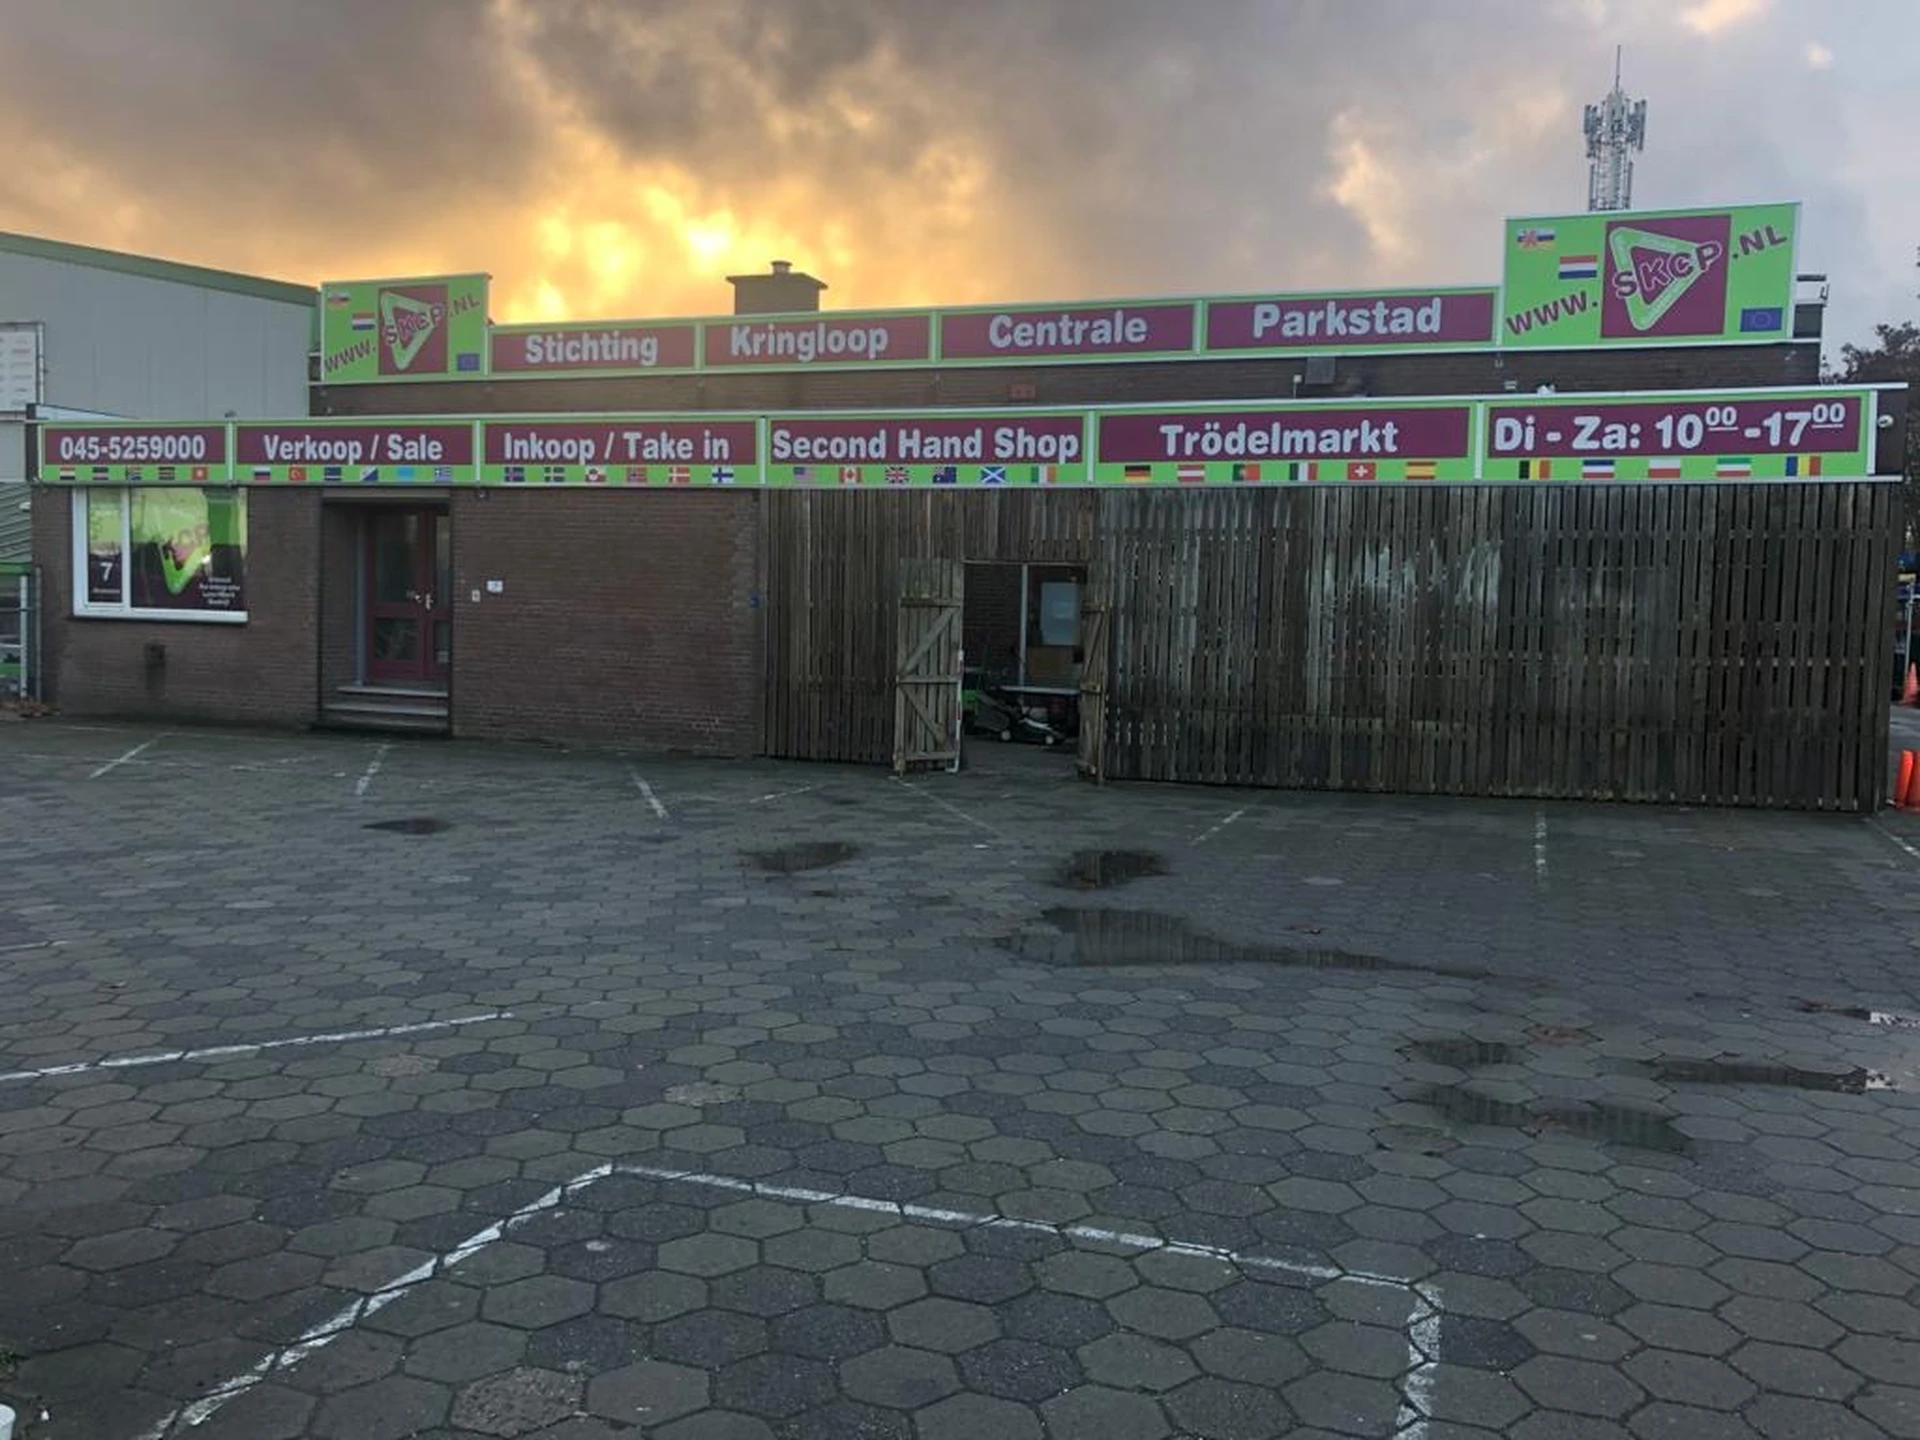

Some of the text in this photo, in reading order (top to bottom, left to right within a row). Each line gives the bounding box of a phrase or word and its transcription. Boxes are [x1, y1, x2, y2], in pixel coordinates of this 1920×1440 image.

[524, 297, 1443, 367] Stichting Kringloop Centrale Parkstad
[60, 434, 206, 460] 045-5259000
[263, 433, 443, 466] Verkoop / Sale
[504, 429, 729, 465] Inkoop / Take in
[772, 426, 1079, 464] Second Hand Shop
[1159, 419, 1399, 457] Trödelmarkt
[1494, 415, 1535, 451] Di
[1571, 414, 1641, 450] Za:
[100, 561, 114, 582] 7
